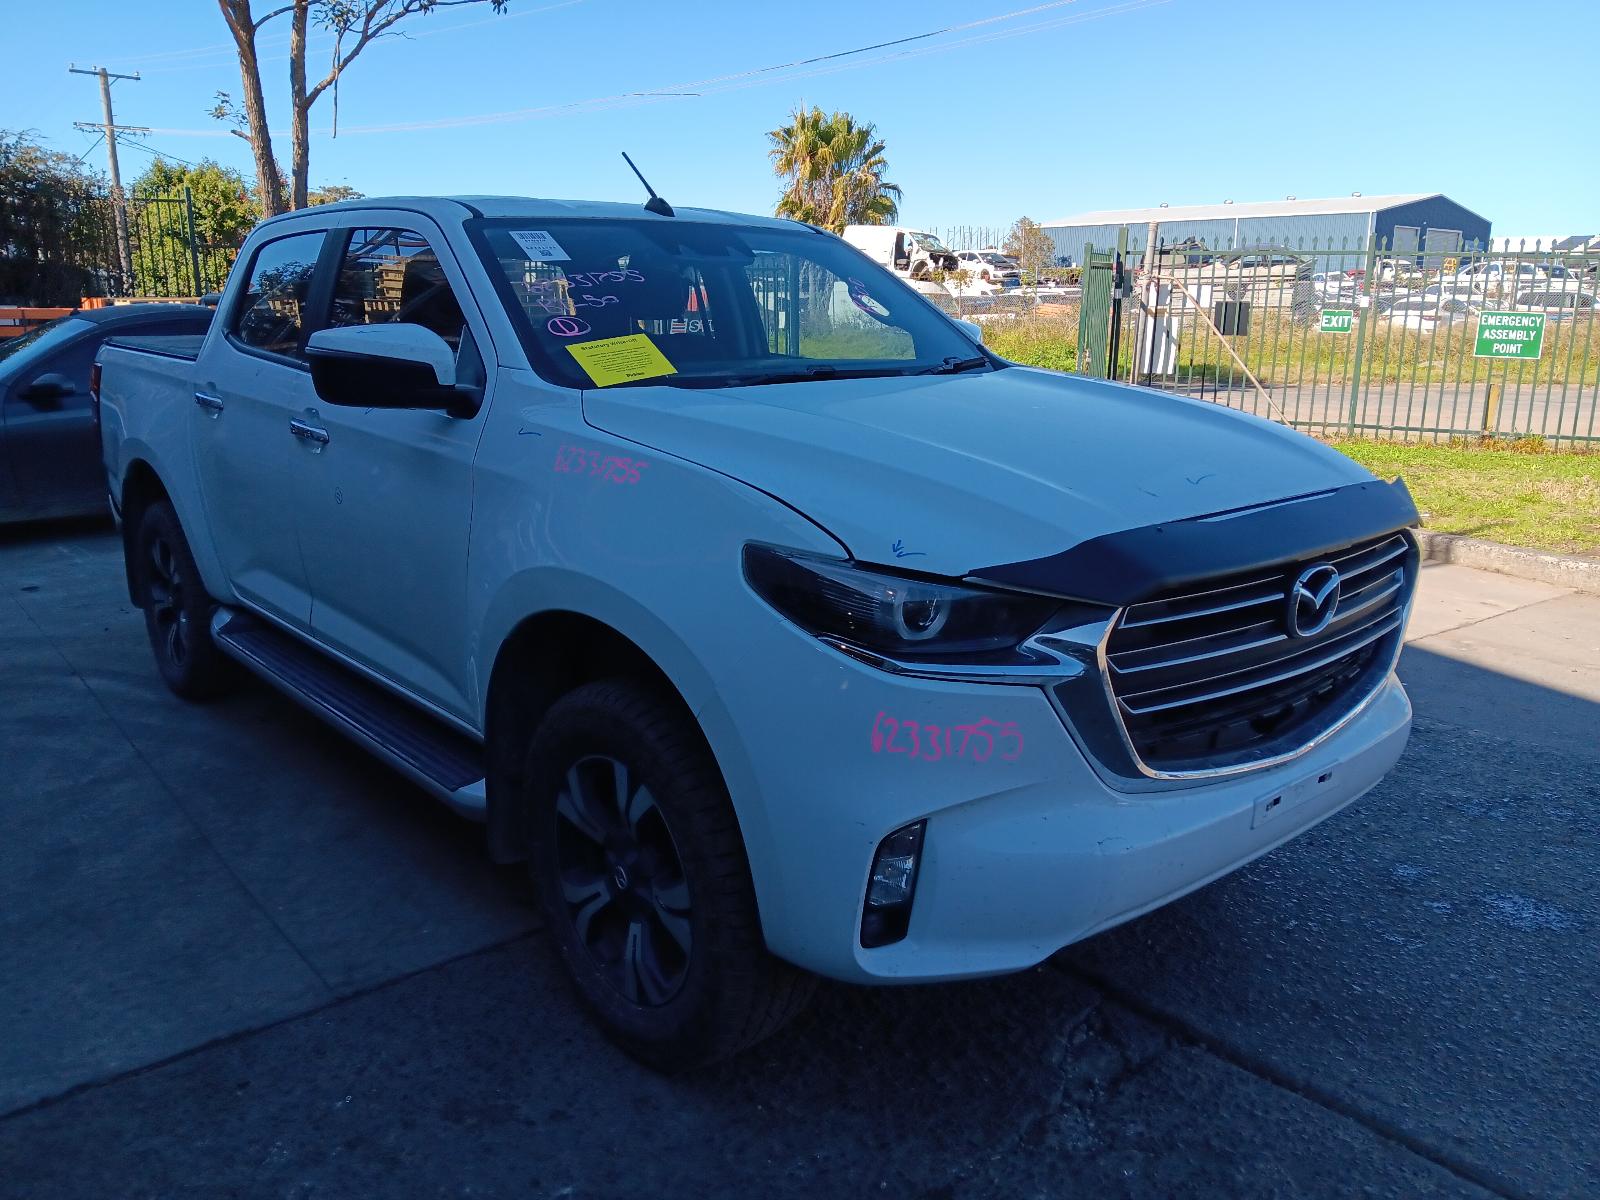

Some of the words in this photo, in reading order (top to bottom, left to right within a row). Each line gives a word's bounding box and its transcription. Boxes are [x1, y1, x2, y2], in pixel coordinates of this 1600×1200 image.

[1322, 315, 1351, 327] EXIT
[1481, 314, 1542, 327] EMERGENCY
[1483, 329, 1536, 341] ASSEMBLY
[1492, 343, 1523, 354] POINT
